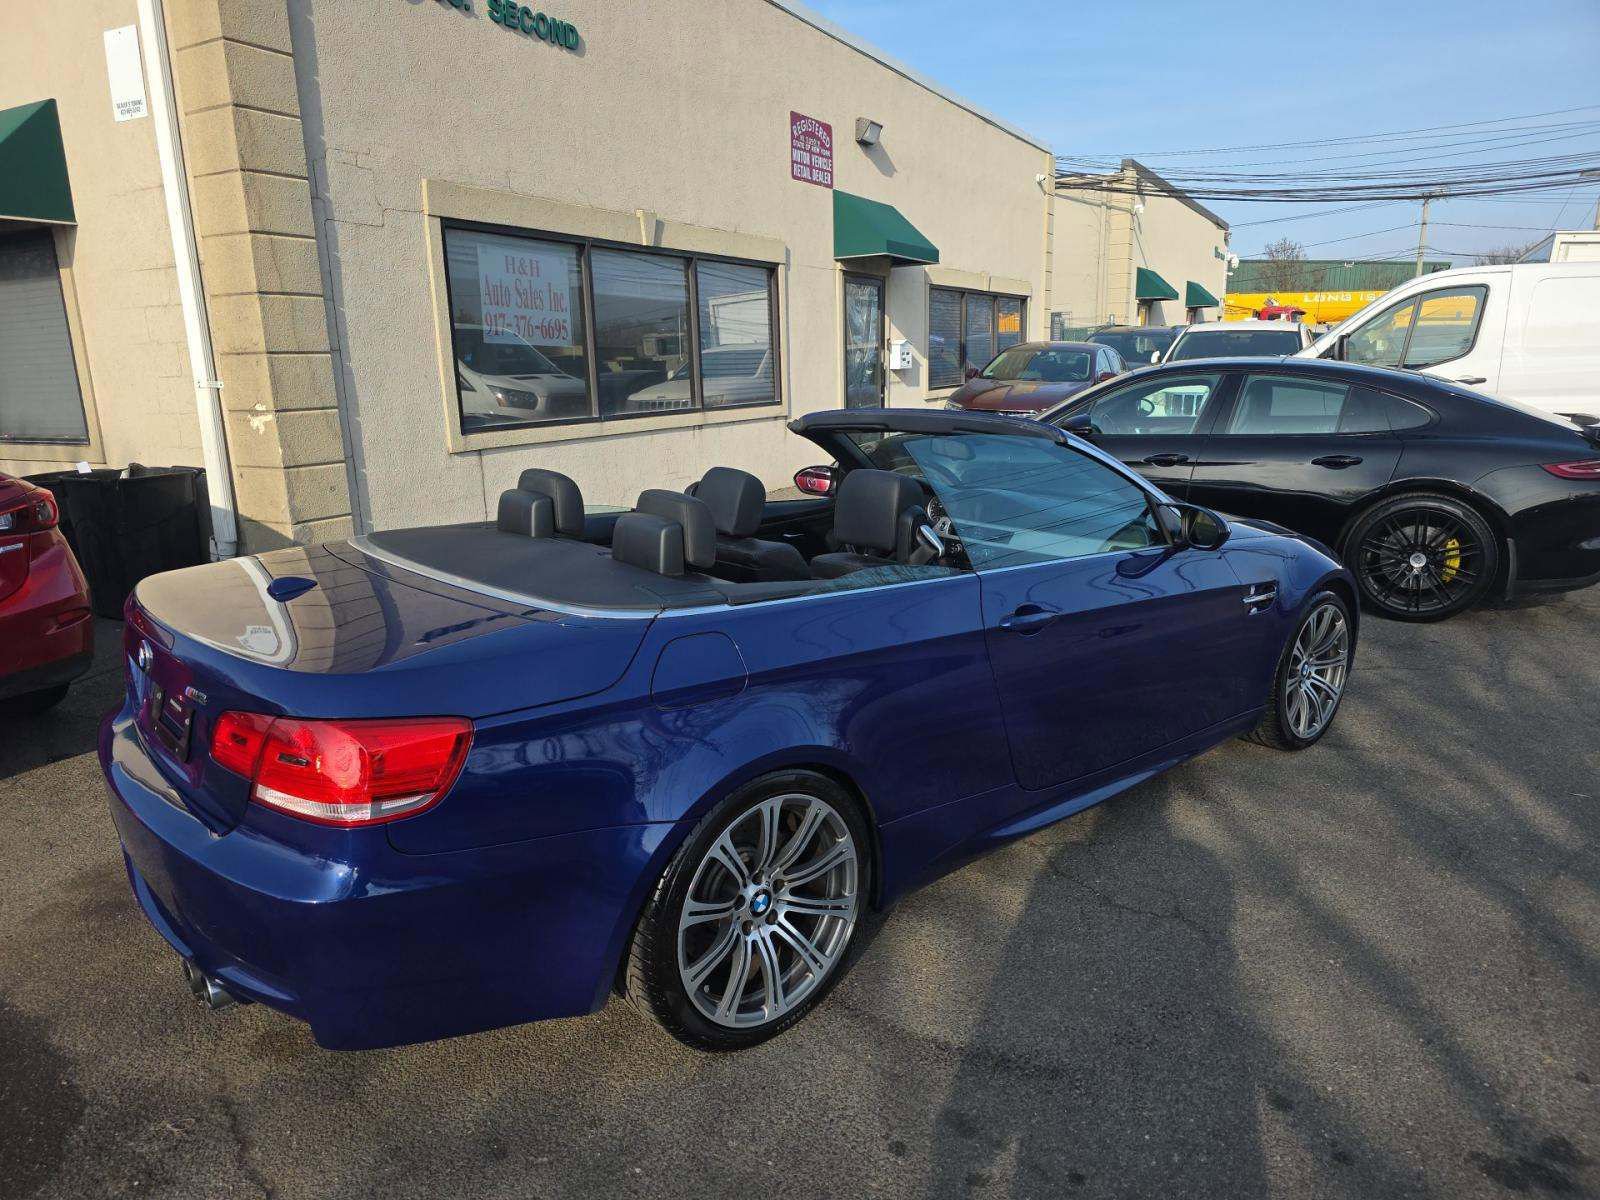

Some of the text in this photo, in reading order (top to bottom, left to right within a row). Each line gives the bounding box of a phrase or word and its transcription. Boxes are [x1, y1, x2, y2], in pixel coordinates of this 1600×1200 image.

[486, 0, 578, 50] SECOND
[792, 119, 831, 148] REGISTERED
[792, 148, 832, 171] MOTOR VEHICLE
[793, 163, 831, 184] RETAIL DEALER
[484, 274, 568, 313] Auto Sales Inc.
[1303, 292, 1352, 303] LONG
[485, 312, 568, 339] 917-376-6695
